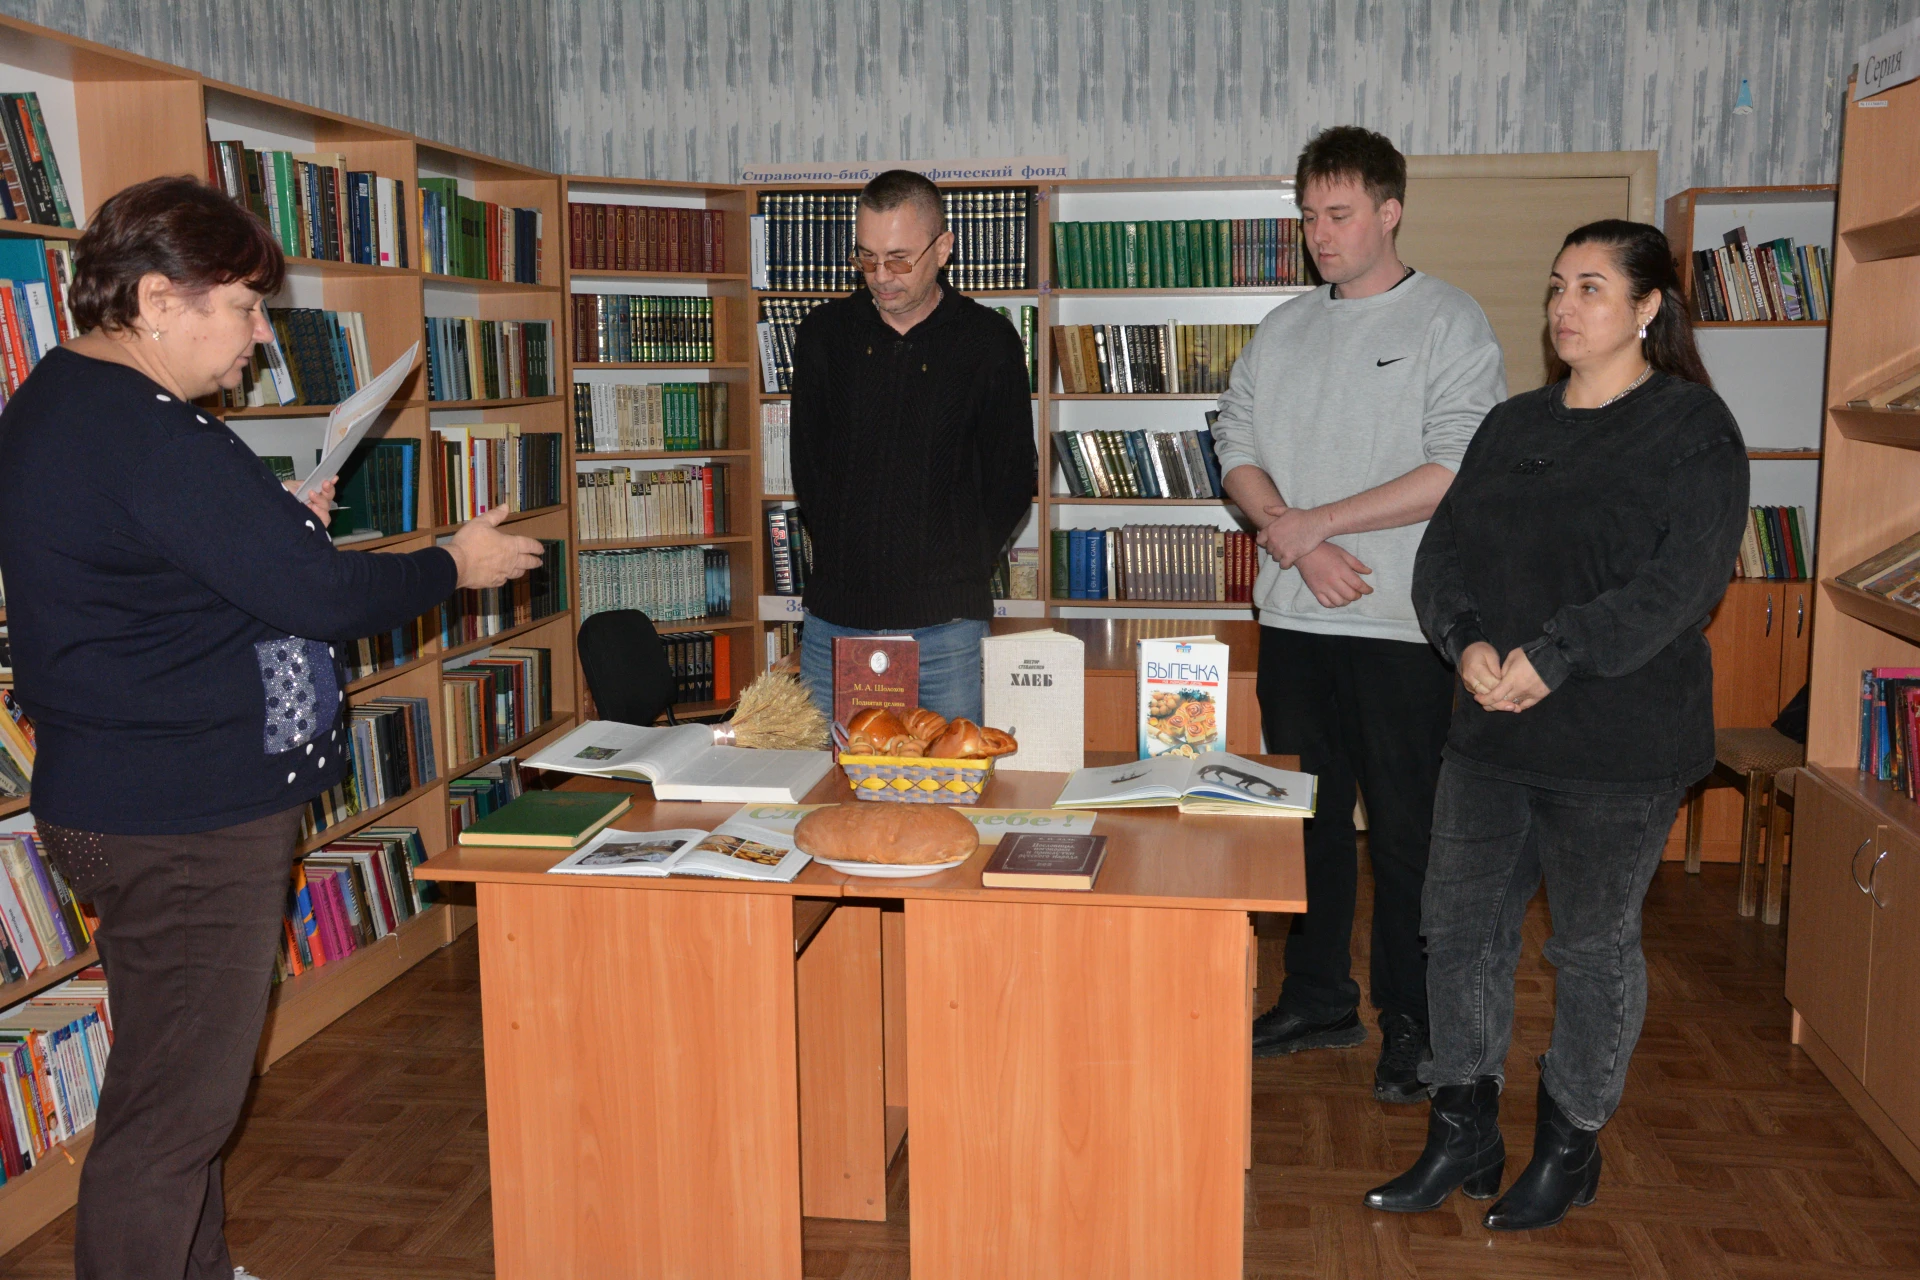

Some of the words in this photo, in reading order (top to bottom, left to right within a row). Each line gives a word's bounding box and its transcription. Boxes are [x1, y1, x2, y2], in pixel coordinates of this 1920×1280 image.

[1865, 50, 1903, 88] Серия
[1021, 165, 1067, 180] фонд
[1741, 241, 1758, 283] ЗАПОРОЖЬЕ
[1753, 285, 1763, 308] НОВОЕ
[8, 353, 16, 368] ДОМ
[636, 439, 640, 447] 4
[650, 437, 654, 445] 6
[658, 438, 662, 446] 7
[1147, 662, 1219, 681] ВЫПЕЧКА
[1010, 673, 1053, 687] ХЛЕБ
[854, 683, 863, 691] М.
[874, 684, 904, 692] Шолохов
[852, 698, 882, 706] Поднятая
